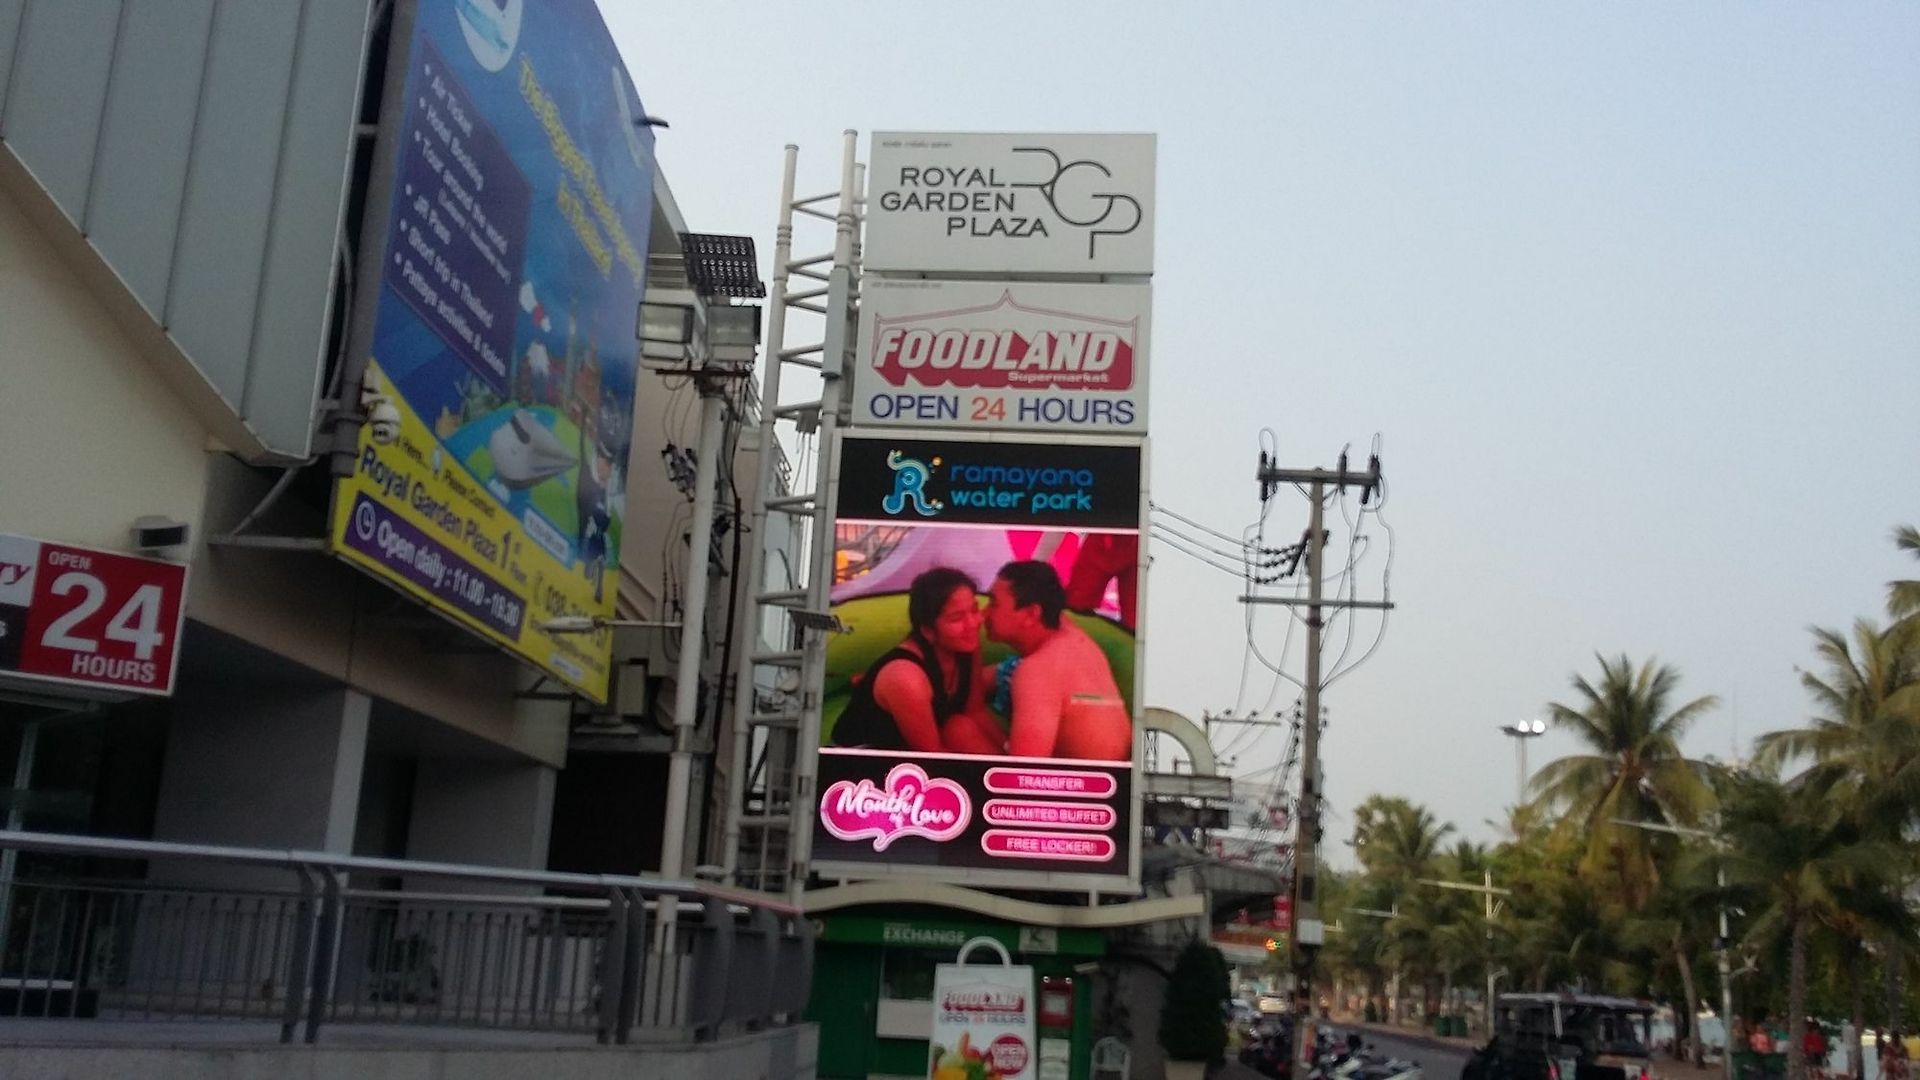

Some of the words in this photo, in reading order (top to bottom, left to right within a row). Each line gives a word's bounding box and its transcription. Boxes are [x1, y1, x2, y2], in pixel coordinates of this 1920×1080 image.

[900, 167, 1006, 187] ROYAL
[880, 191, 1015, 212] GARDEN
[947, 217, 1049, 238] PLAZA
[872, 328, 1120, 372] FOODLAND
[1007, 371, 1110, 384] Supermarket
[869, 394, 959, 420] OPEN
[970, 396, 1007, 421] 24
[1018, 397, 1136, 425] HOURS
[950, 464, 1094, 490] ramayana
[360, 443, 411, 501] Royal
[411, 480, 462, 538] Garden
[462, 518, 498, 563] Plaza
[950, 486, 1025, 508] water
[1031, 489, 1093, 513] park
[48, 551, 92, 569] OPEN
[377, 519, 416, 564] Open
[415, 545, 447, 588] daily
[41, 571, 165, 661] 24
[72, 653, 157, 684] HOURS
[991, 805, 1059, 822] UNLIMITED
[1059, 808, 1107, 824] BUFFET
[1006, 837, 1040, 851] FREE
